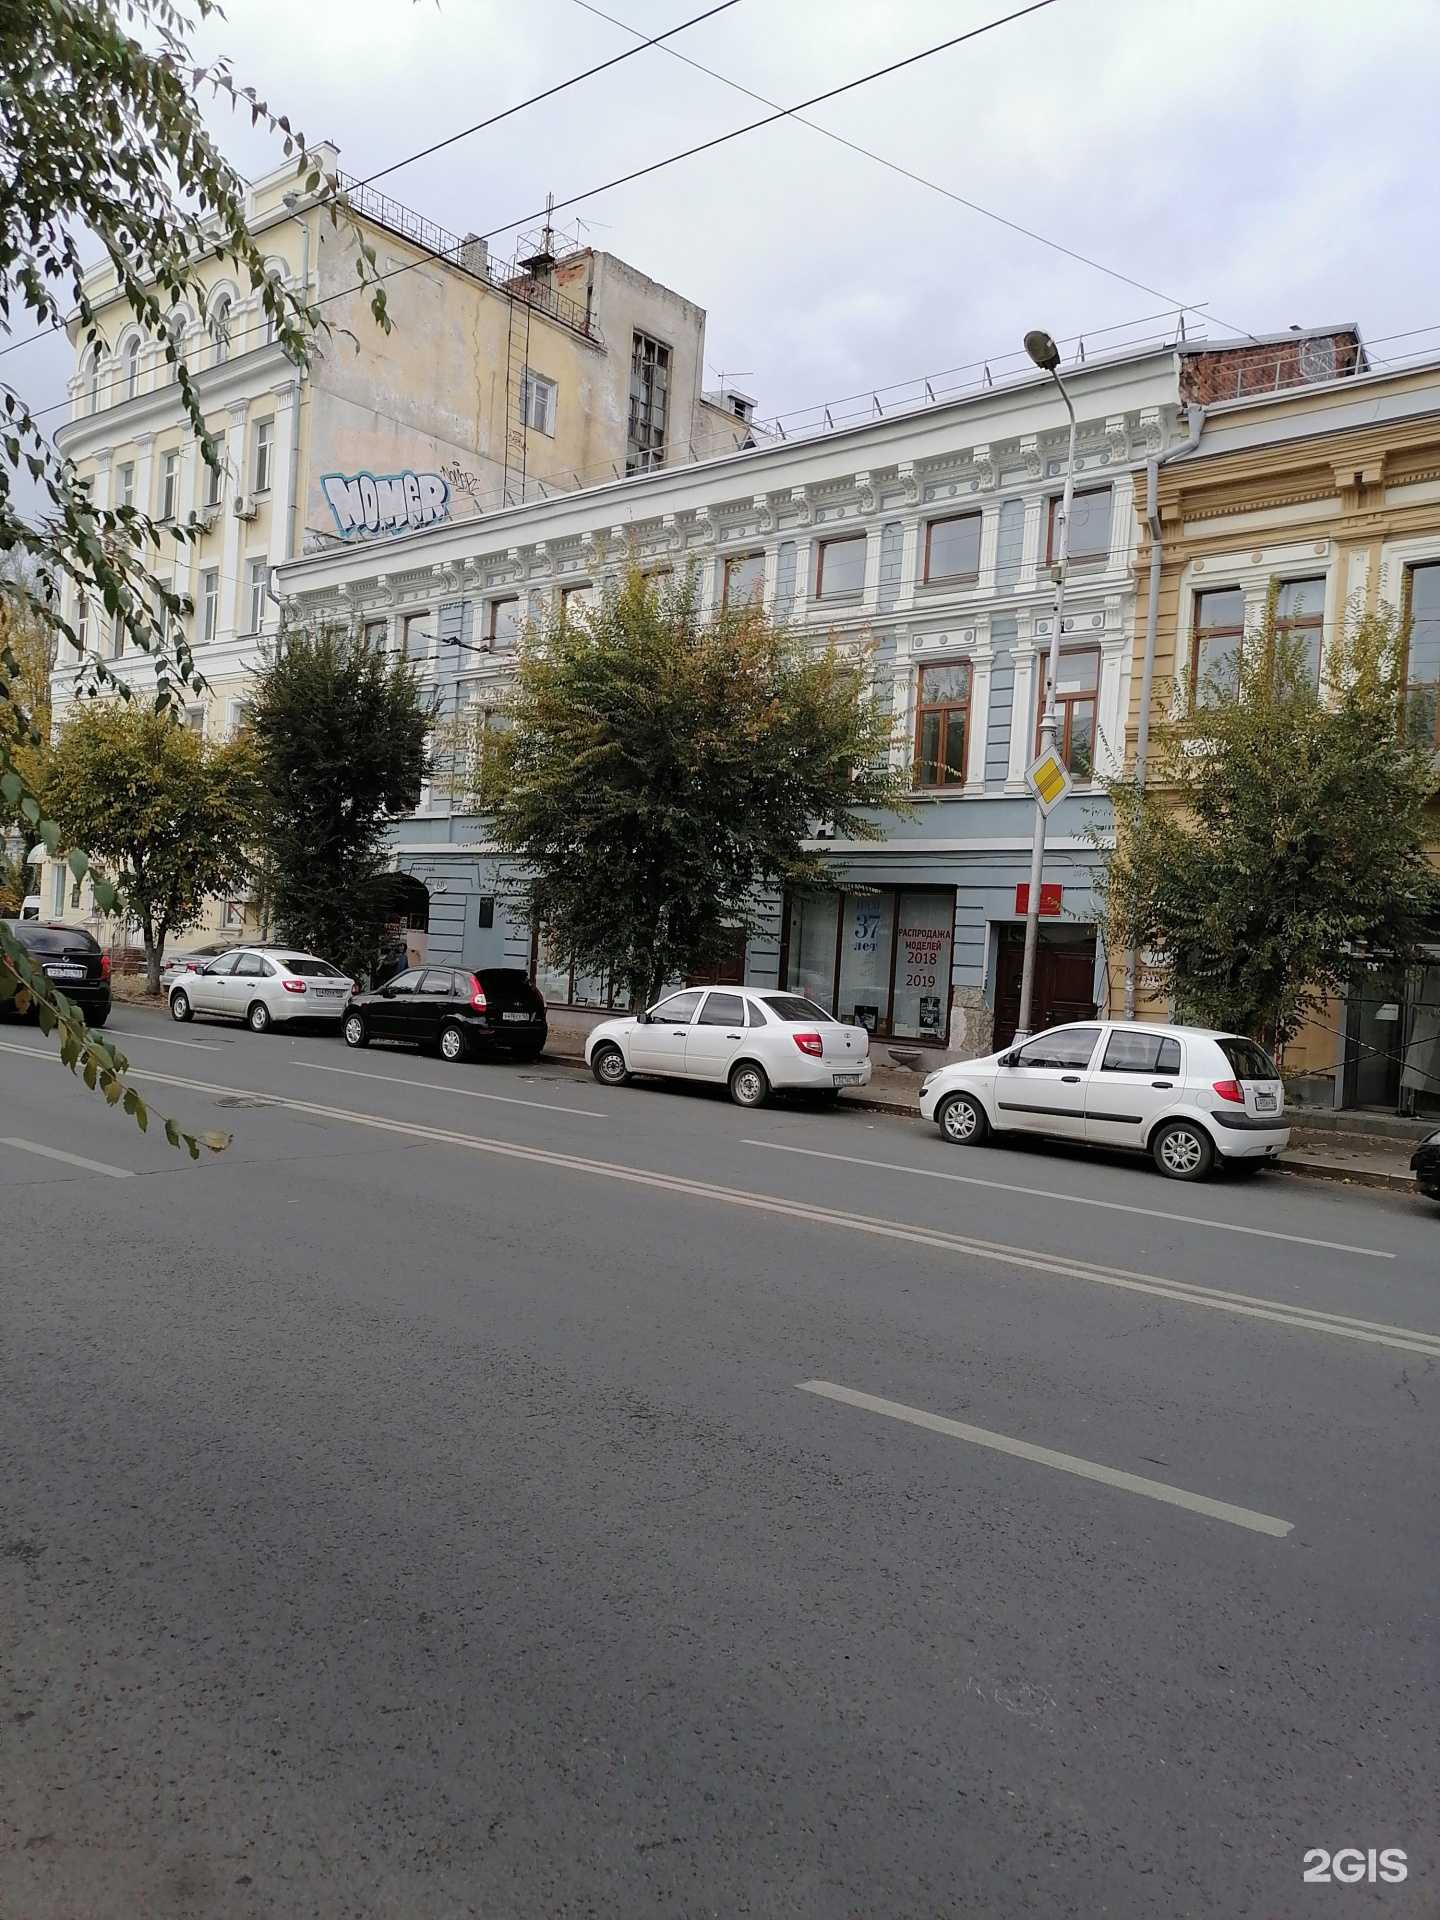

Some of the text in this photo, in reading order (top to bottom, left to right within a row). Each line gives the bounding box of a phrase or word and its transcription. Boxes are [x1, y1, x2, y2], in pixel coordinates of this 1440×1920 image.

[855, 914, 880, 939] 37
[898, 928, 950, 939] РАСПРОДАЖА
[854, 942, 878, 952] лет
[905, 940, 942, 951] МОДЕЛЕЙ
[907, 951, 937, 965] 2018
[905, 974, 936, 988] 2019
